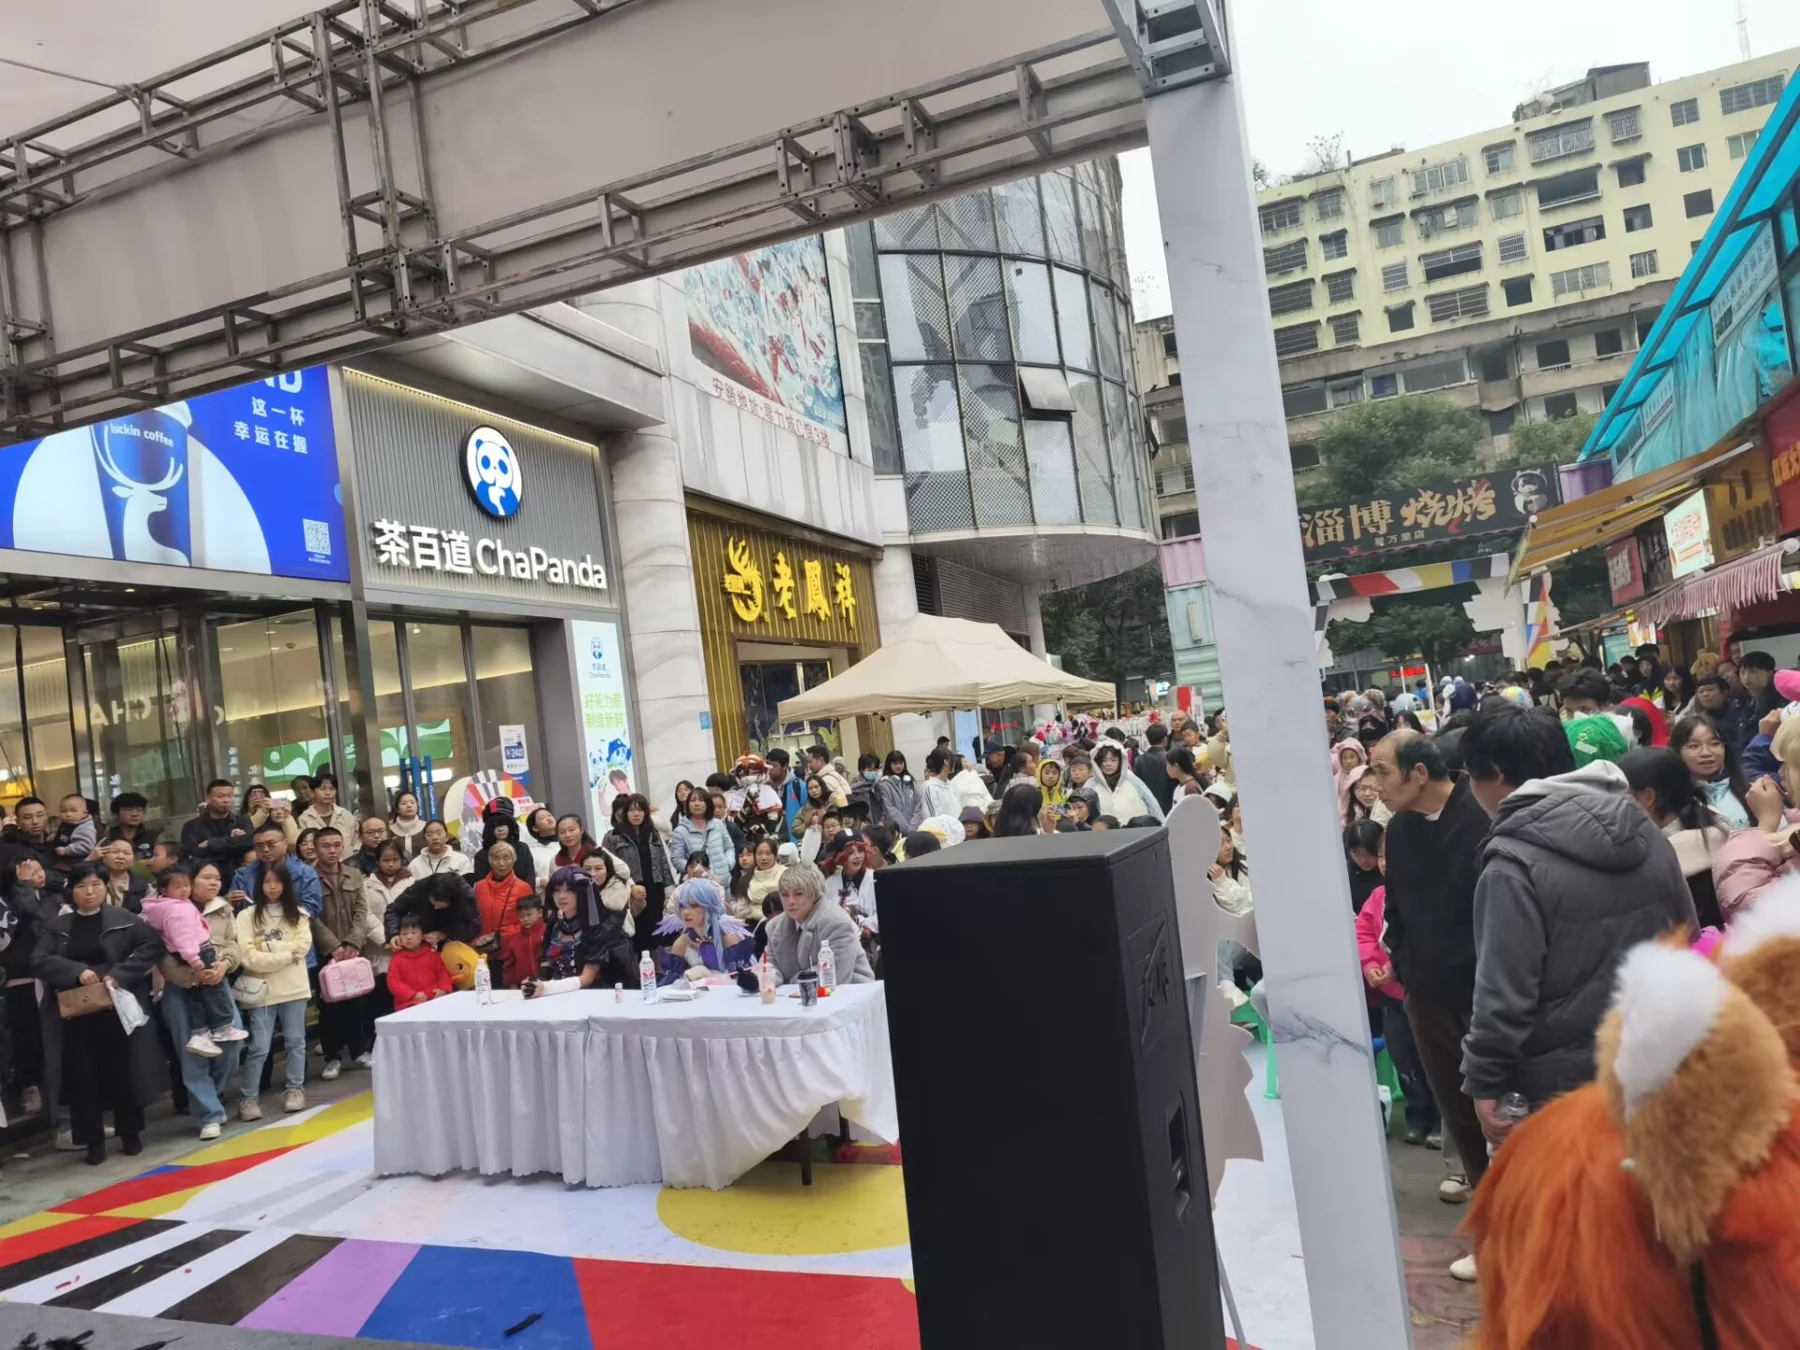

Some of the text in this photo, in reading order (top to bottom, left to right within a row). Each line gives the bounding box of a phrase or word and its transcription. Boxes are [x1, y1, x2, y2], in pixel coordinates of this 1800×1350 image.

[251, 396, 305, 427] 这一杯
[110, 422, 174, 448] luckin coffee
[233, 420, 308, 454] 幸运在握
[1299, 482, 1496, 548] 淄博烧烤
[374, 518, 608, 590] 茶百道 ChaPanda
